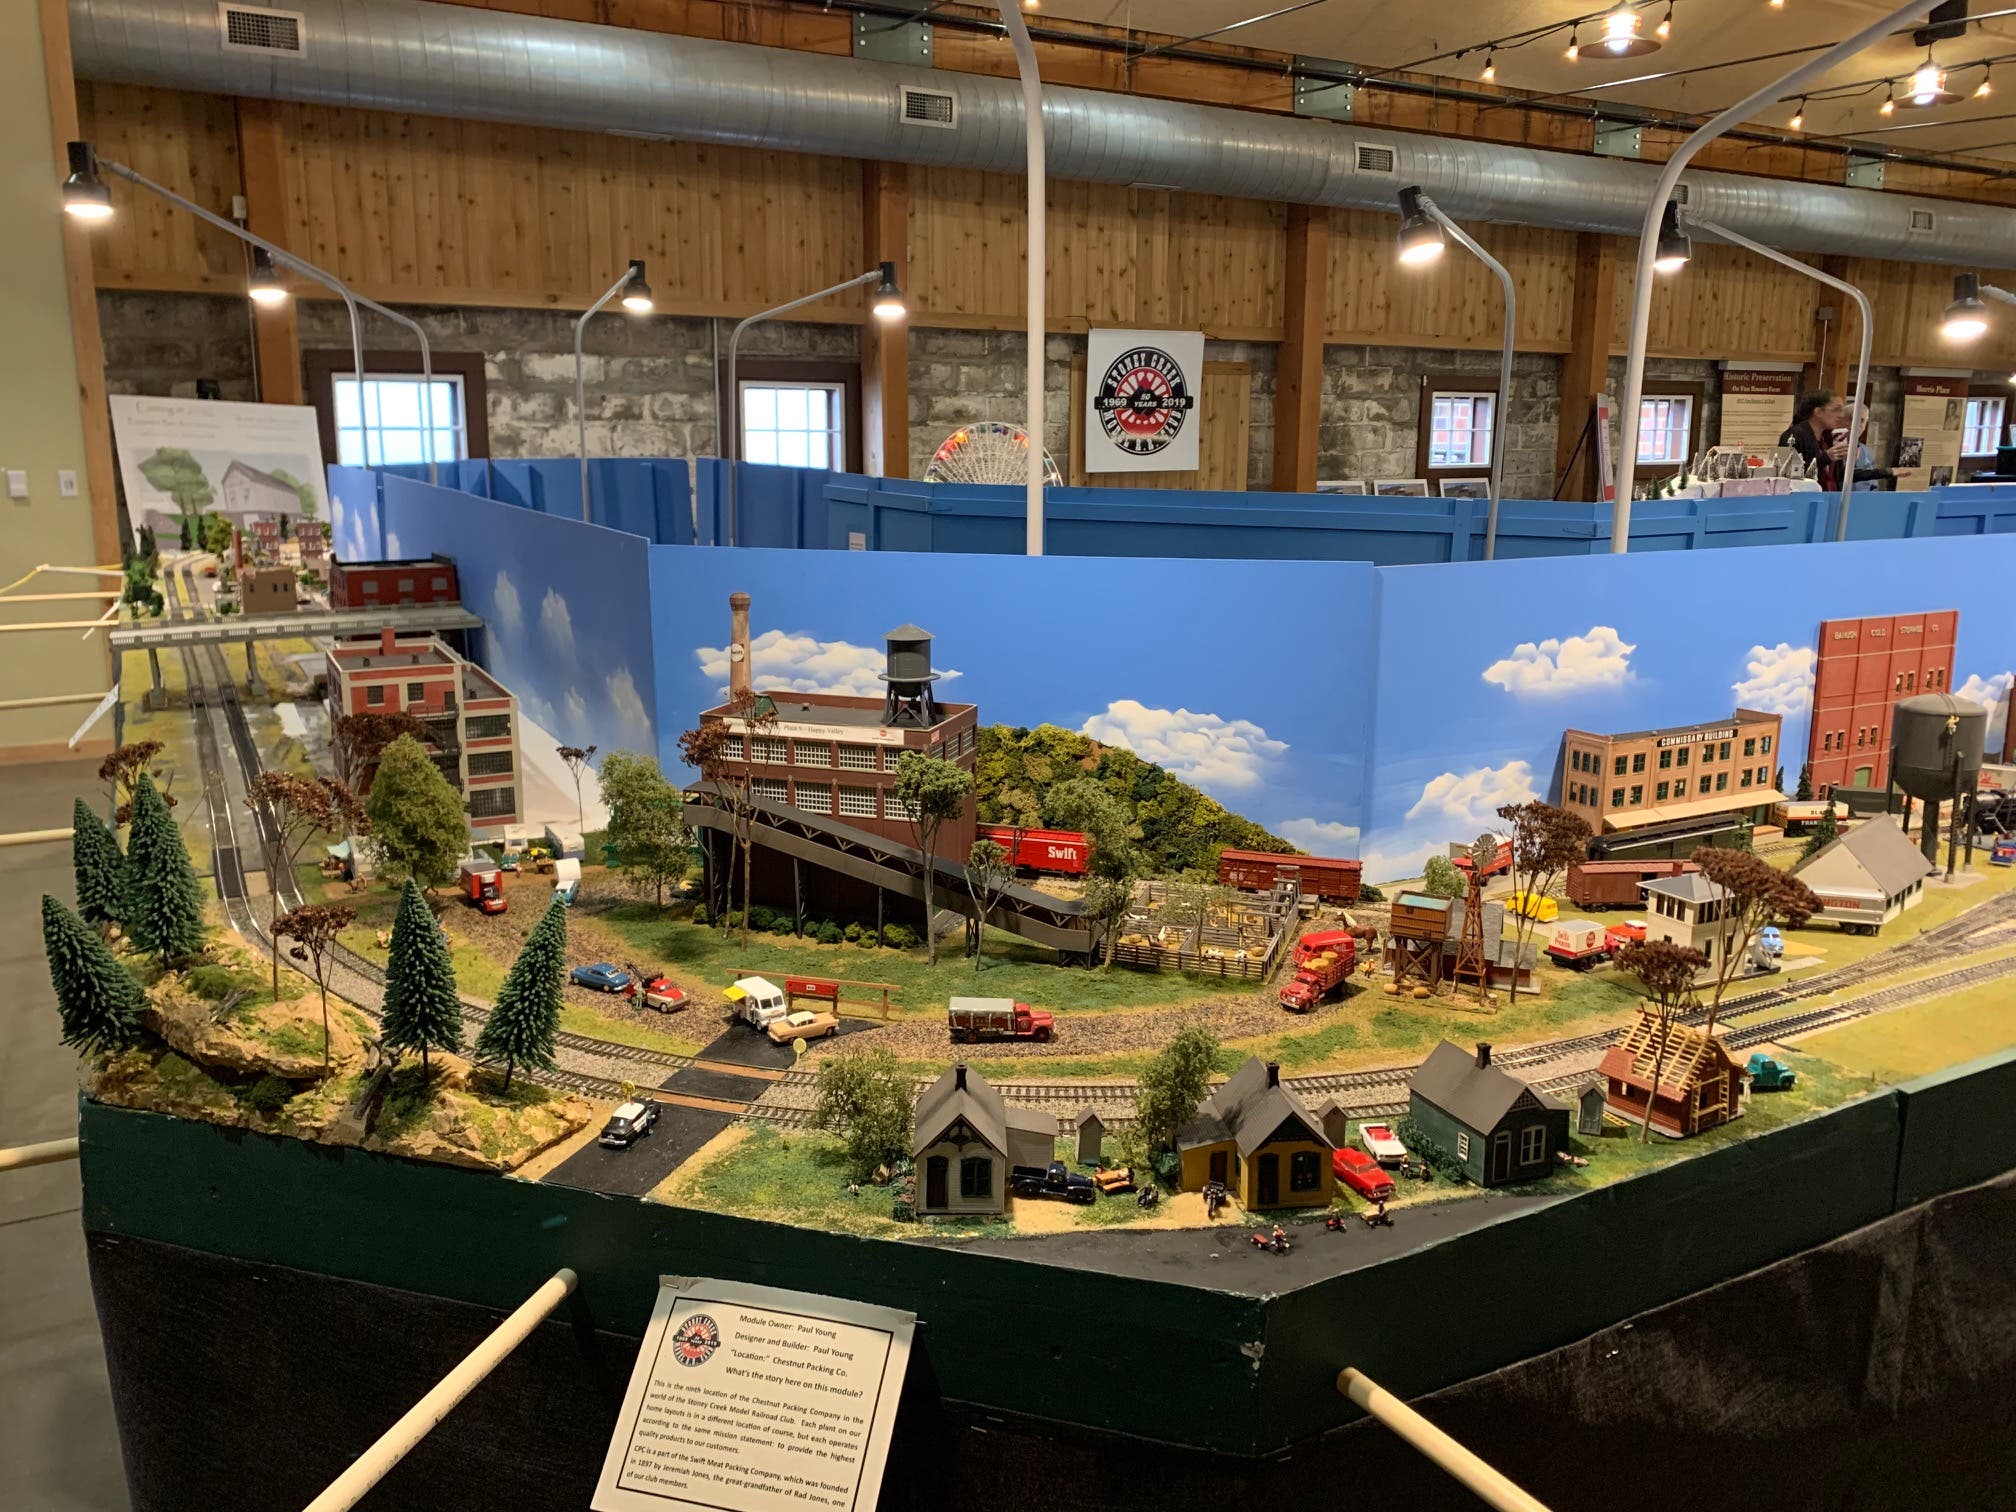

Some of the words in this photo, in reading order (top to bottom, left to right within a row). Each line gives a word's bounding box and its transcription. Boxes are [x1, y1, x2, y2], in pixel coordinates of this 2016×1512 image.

[1107, 352, 1146, 388] STONEY
[1150, 353, 1181, 388] CREEK
[1723, 371, 1750, 381] Historic
[1751, 373, 1792, 383] Preservation
[1103, 397, 1127, 407] 1969
[1134, 400, 1157, 408] YEARS
[1140, 393, 1151, 401] 50
[1162, 397, 1186, 408] 2019
[827, 728, 844, 736] Valley
[1661, 733, 1704, 747] COMMISSARY
[1704, 730, 1734, 741] BUILDING
[1048, 846, 1077, 860] Swift
[739, 1315, 766, 1326] Module
[768, 1320, 792, 1329] Owner:
[797, 1324, 814, 1333] Paul
[815, 1327, 837, 1339] Young
[735, 1331, 766, 1343] Designer
[782, 1340, 810, 1351] Builder:
[813, 1345, 830, 1354] Paul
[831, 1348, 854, 1361] Young
[773, 1357, 805, 1369] Chestnut
[806, 1362, 835, 1376] Packing
[836, 1368, 848, 1377] Co.
[726, 1367, 750, 1377] What's
[751, 1371, 764, 1380] the
[765, 1374, 784, 1385] story
[784, 1377, 802, 1387] here
[814, 1383, 828, 1392] this
[829, 1387, 863, 1398] module?
[688, 1398, 708, 1409] Stoney
[709, 1402, 727, 1411] Creek
[729, 1406, 750, 1415] Model
[751, 1410, 778, 1421] Railroad
[779, 1415, 796, 1424] Club.
[801, 1419, 817, 1428] Each
[818, 1423, 836, 1432] plant
[703, 1388, 728, 1398] location
[752, 1397, 780, 1408] Chestnut
[782, 1403, 807, 1415] Packing
[809, 1408, 841, 1421] Company
[646, 1404, 663, 1412] home
[664, 1407, 685, 1417] layouts
[707, 1416, 734, 1426] different
[736, 1421, 761, 1431] location
[772, 1429, 795, 1438] course,
[797, 1432, 809, 1440] but
[811, 1436, 827, 1444] each
[829, 1440, 858, 1450] operates
[639, 1430, 659, 1439] quality
[659, 1434, 685, 1443] products
[706, 1443, 739, 1453] customers.
[642, 1418, 670, 1428] according
[694, 1427, 711, 1435] same
[713, 1431, 737, 1439] mission
[740, 1436, 774, 1447] statement:
[787, 1445, 813, 1455] provide
[816, 1450, 827, 1458] the
[830, 1452, 855, 1463] highest
[634, 1445, 646, 1453] CPC
[690, 1456, 706, 1465] Swift
[707, 1459, 724, 1469] Meat
[725, 1462, 749, 1475] Packing
[750, 1467, 782, 1481] Company,
[784, 1475, 804, 1484] which
[805, 1480, 818, 1488] was
[820, 1481, 849, 1494] founded
[645, 1474, 658, 1483] club
[658, 1478, 688, 1488] members.
[638, 1459, 653, 1467] 1897
[654, 1462, 661, 1471] by
[663, 1464, 690, 1475] Jeremiah
[691, 1470, 710, 1480] Jones,
[713, 1474, 724, 1482] the
[725, 1478, 783, 1494] great-grandfather
[793, 1490, 808, 1499] Rad
[809, 1494, 830, 1505] Jones,
